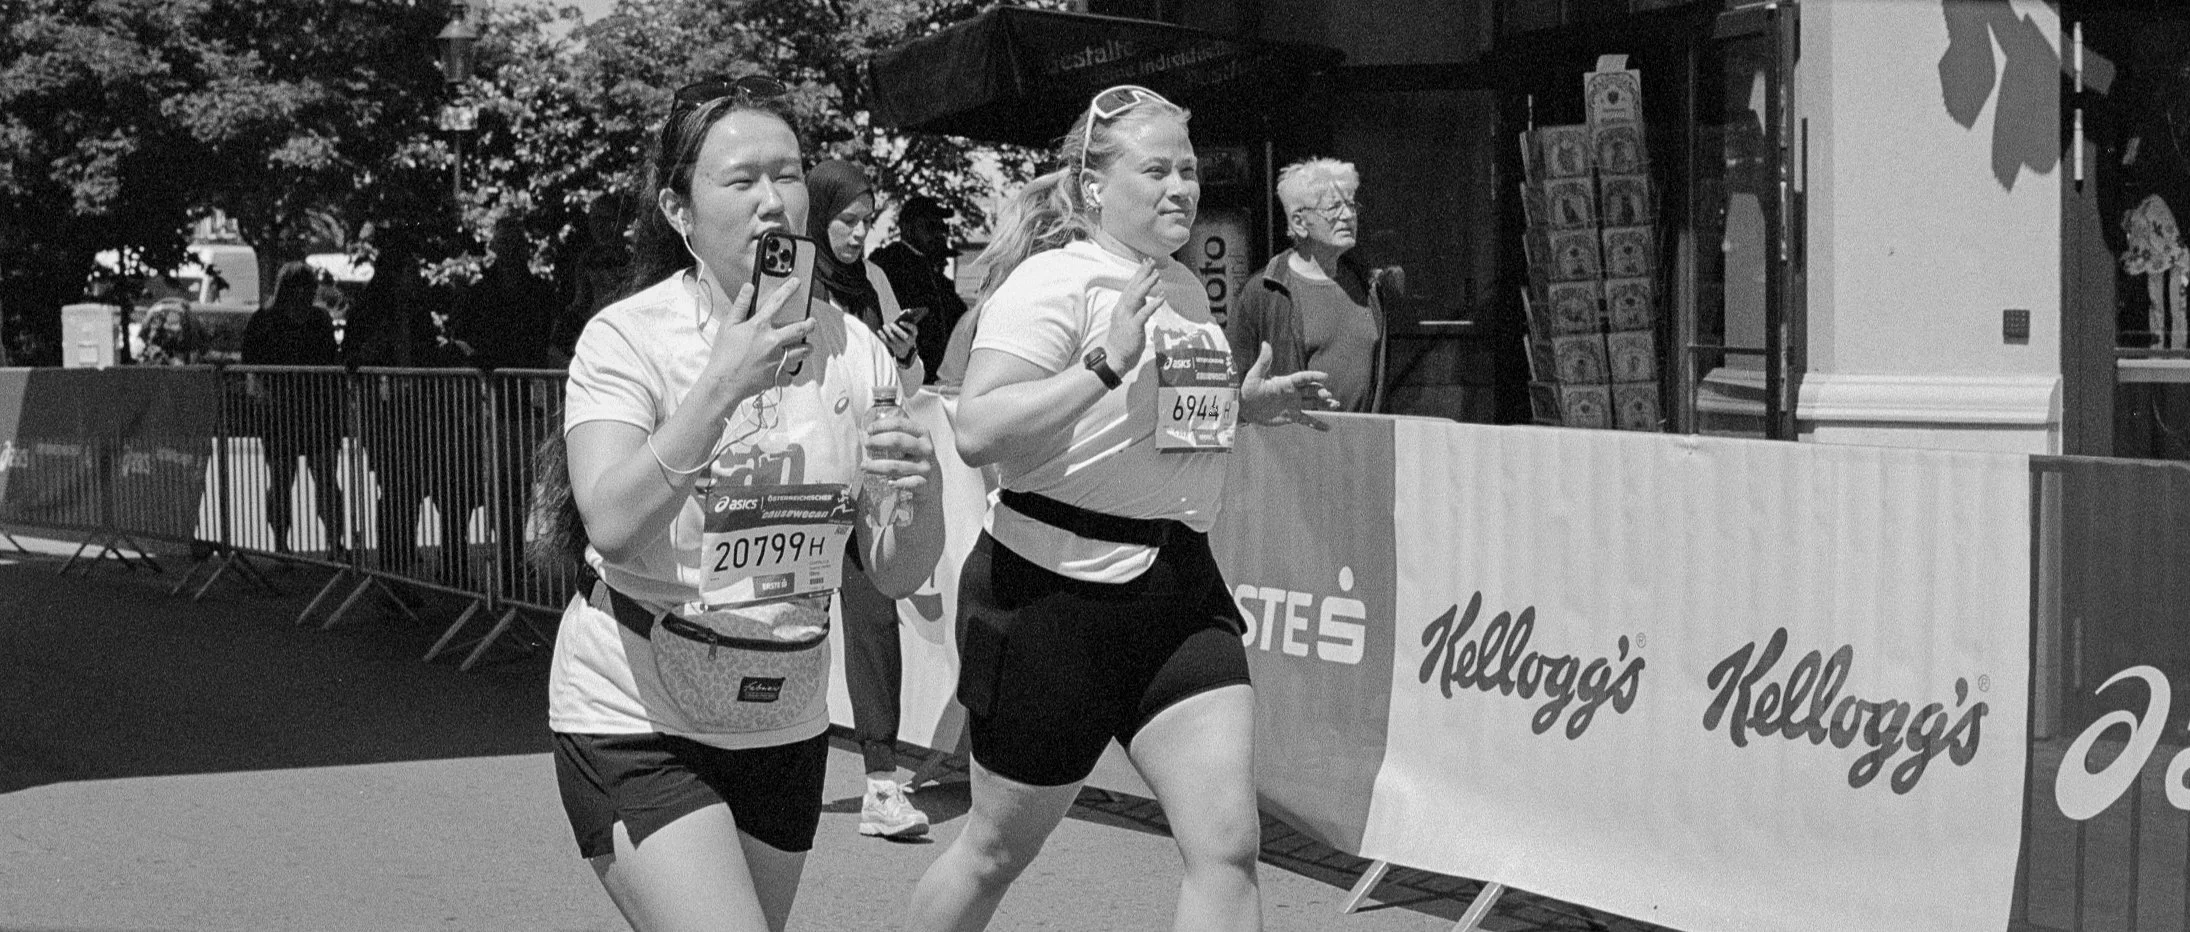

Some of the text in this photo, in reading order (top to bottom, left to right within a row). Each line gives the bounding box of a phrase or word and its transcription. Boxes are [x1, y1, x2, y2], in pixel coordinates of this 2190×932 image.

[1172, 395, 1220, 422] 6944
[728, 498, 759, 511] asics
[713, 531, 806, 573] 20799
[809, 536, 827, 557] H
[1225, 583, 1313, 657] STE
[1418, 590, 1646, 740] Kellogg's
[1703, 627, 1989, 795] Kellogg's
